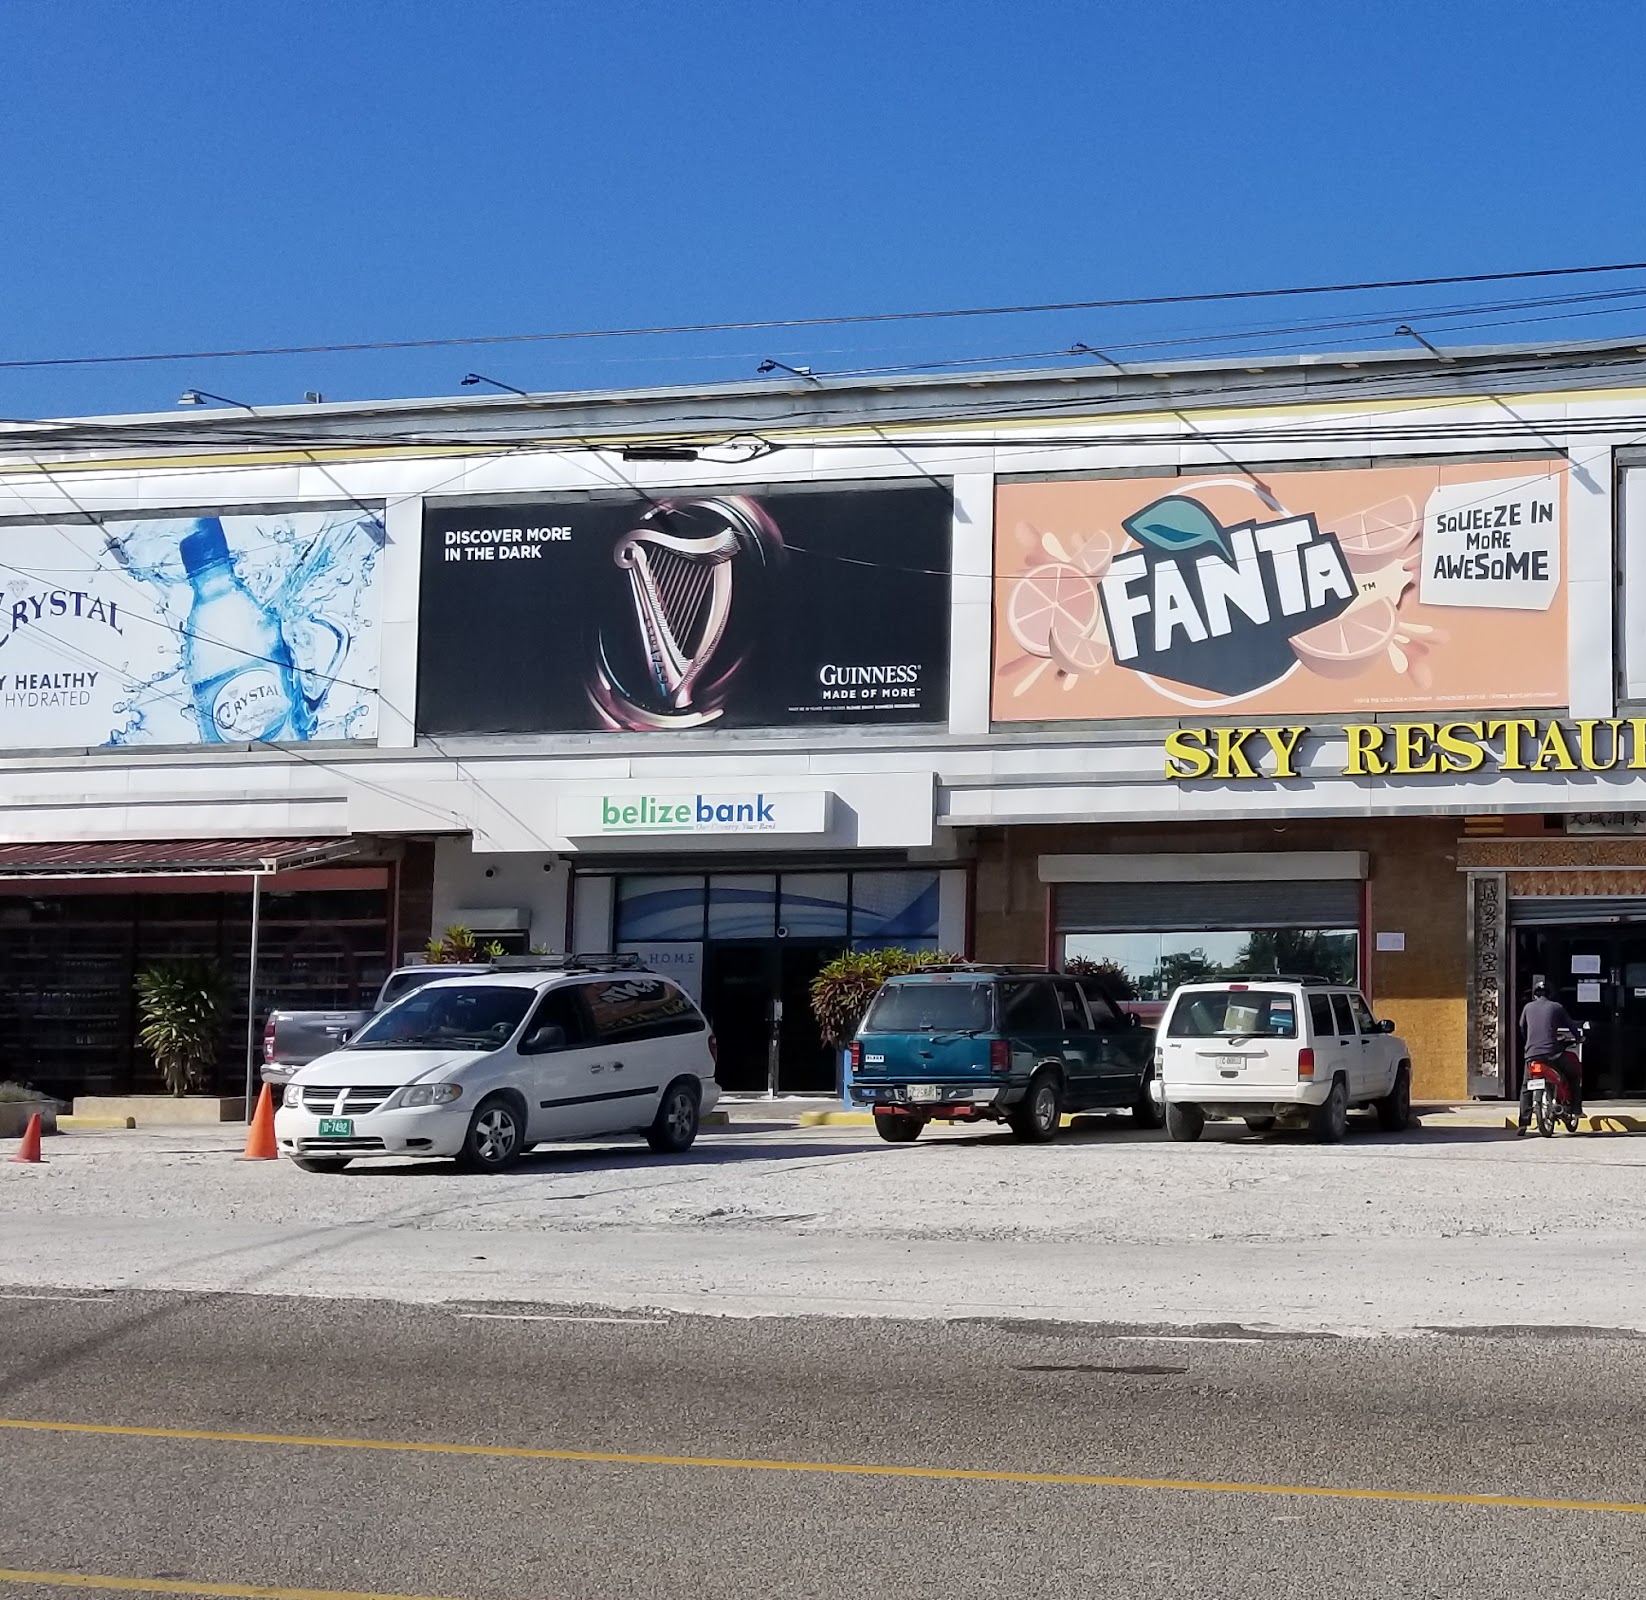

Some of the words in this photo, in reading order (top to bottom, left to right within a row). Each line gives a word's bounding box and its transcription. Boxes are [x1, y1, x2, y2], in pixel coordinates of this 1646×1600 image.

[1437, 502, 1521, 533] SQUEEZE
[1531, 500, 1553, 523] IN
[445, 528, 523, 545] DISCOVER
[526, 526, 572, 542] MORE
[1466, 530, 1511, 550] MORE
[445, 547, 461, 561] IN
[464, 546, 495, 561] THE
[498, 544, 542, 560] DARK
[1433, 550, 1549, 580] AWESOME
[1101, 520, 1353, 661] FANTA
[0, 590, 123, 648] RYSTAL
[15, 671, 99, 690] HEALTHY
[820, 664, 918, 686] GUINNESS
[5, 690, 91, 708] HYDRATED
[823, 690, 857, 699] MADE
[861, 689, 877, 698] OF
[1164, 726, 1306, 780] SKY
[650, 953, 695, 964] HOME
